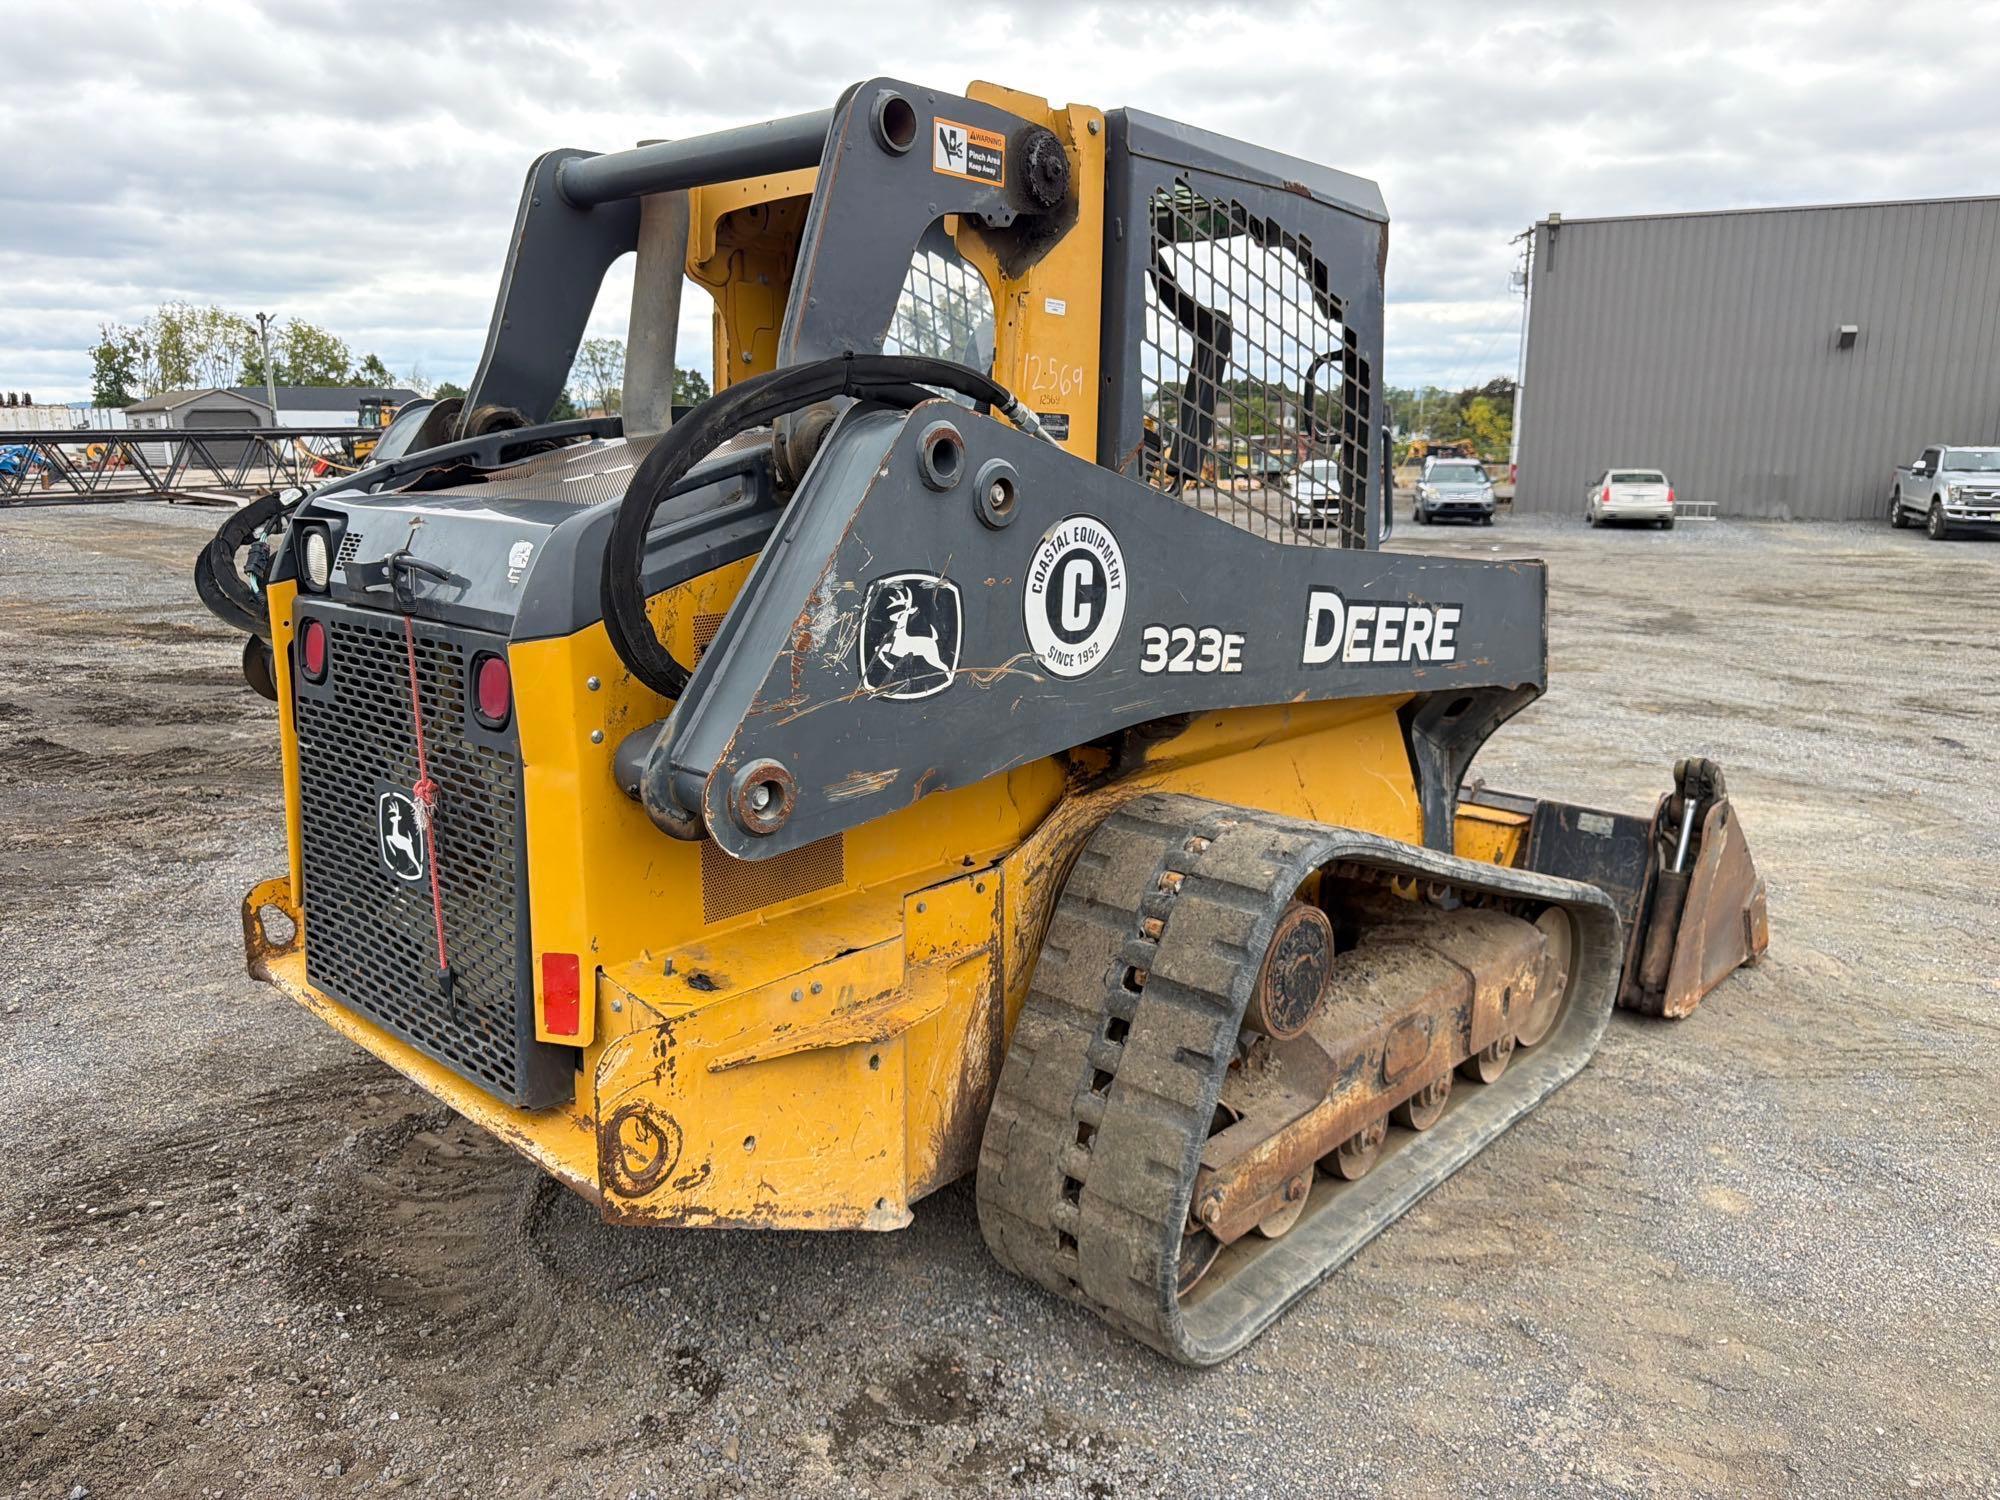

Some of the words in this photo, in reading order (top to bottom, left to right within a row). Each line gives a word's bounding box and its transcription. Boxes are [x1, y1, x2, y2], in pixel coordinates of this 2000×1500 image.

[975, 133, 1002, 146] WARNING
[968, 150, 986, 161] Pinch
[986, 155, 1000, 165] Area
[968, 162, 981, 172] Keep
[982, 165, 996, 176] Away
[1023, 352, 1083, 396] 12569
[1039, 394, 1061, 405] 12569
[1031, 530, 1071, 595] COASTAL
[1073, 526, 1121, 591] EQUIPMENT
[1061, 558, 1094, 632] C
[1302, 591, 1462, 664] DEERE
[1047, 645, 1074, 667] SINCE
[1076, 641, 1101, 666] 1952
[1140, 626, 1246, 673] 323E
